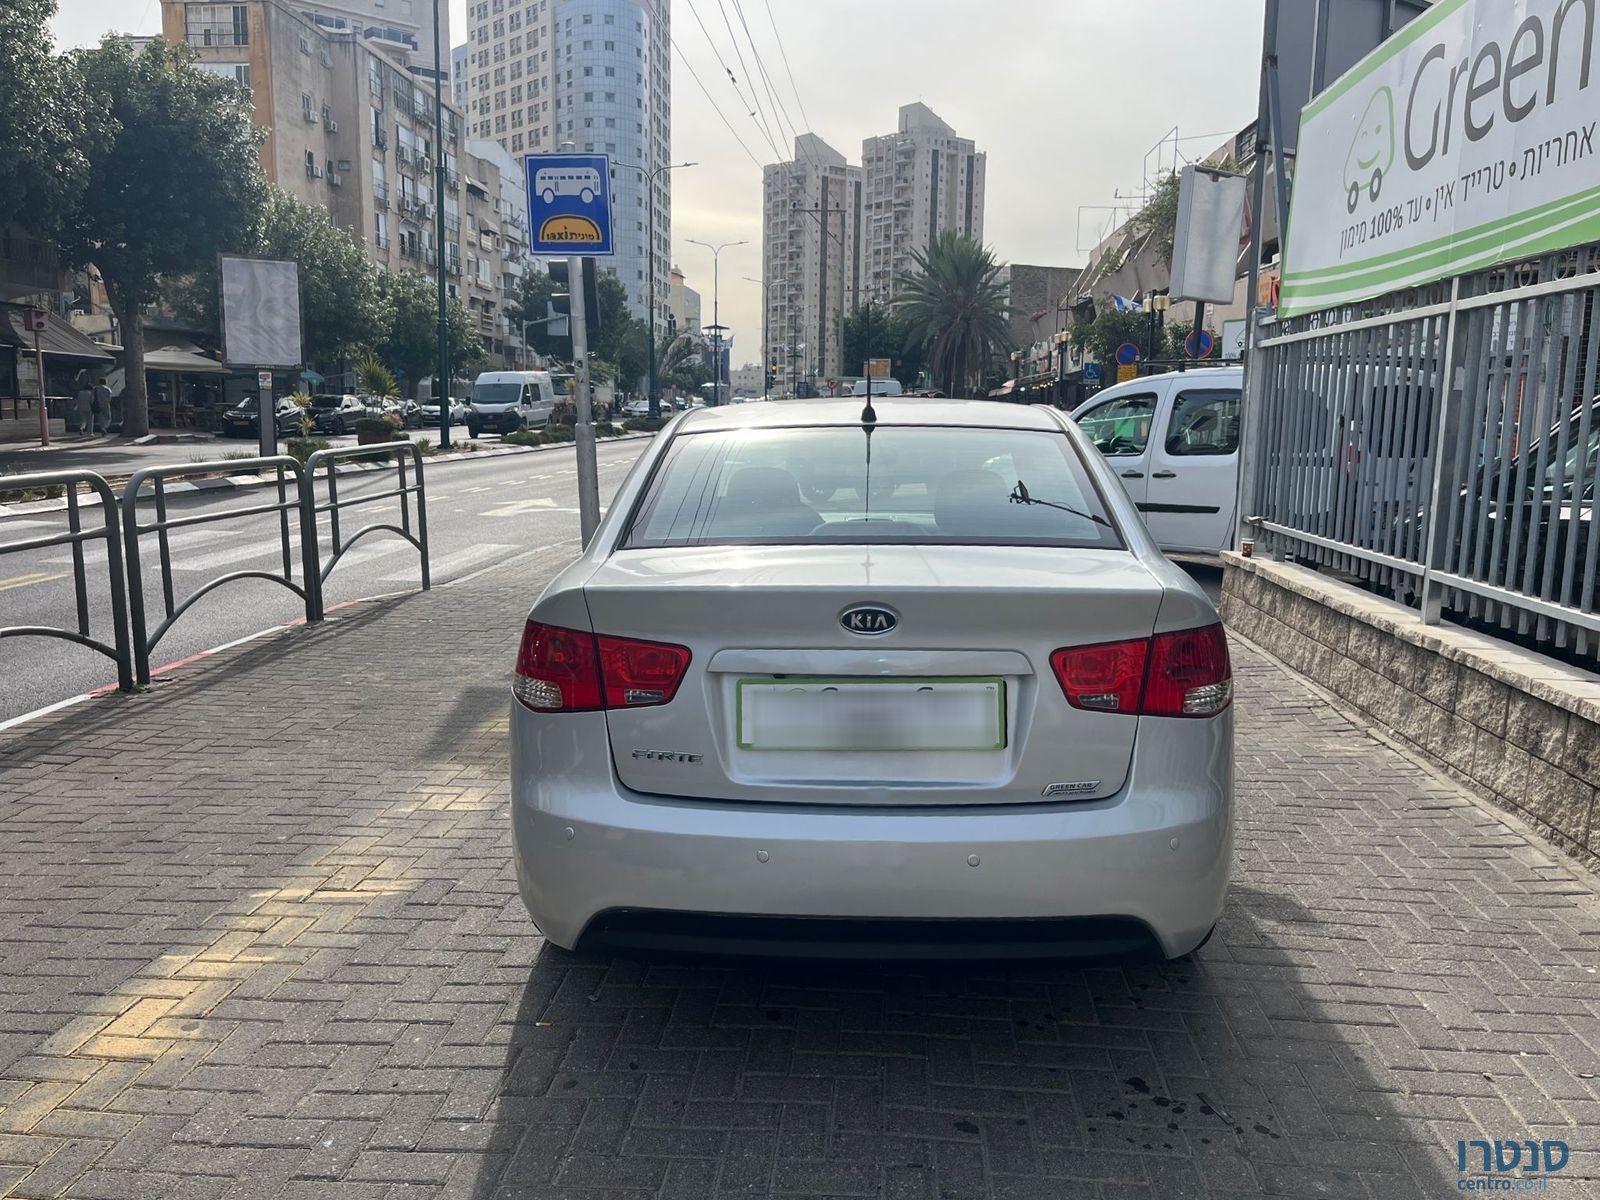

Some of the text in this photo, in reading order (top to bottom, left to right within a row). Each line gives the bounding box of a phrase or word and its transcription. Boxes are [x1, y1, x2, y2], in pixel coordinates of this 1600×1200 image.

[1404, 0, 1596, 172] Green
[1340, 121, 1597, 260] אחריות טרייד אין עד 100% מימון
[569, 231, 595, 241] מונית
[850, 613, 889, 629] KIA
